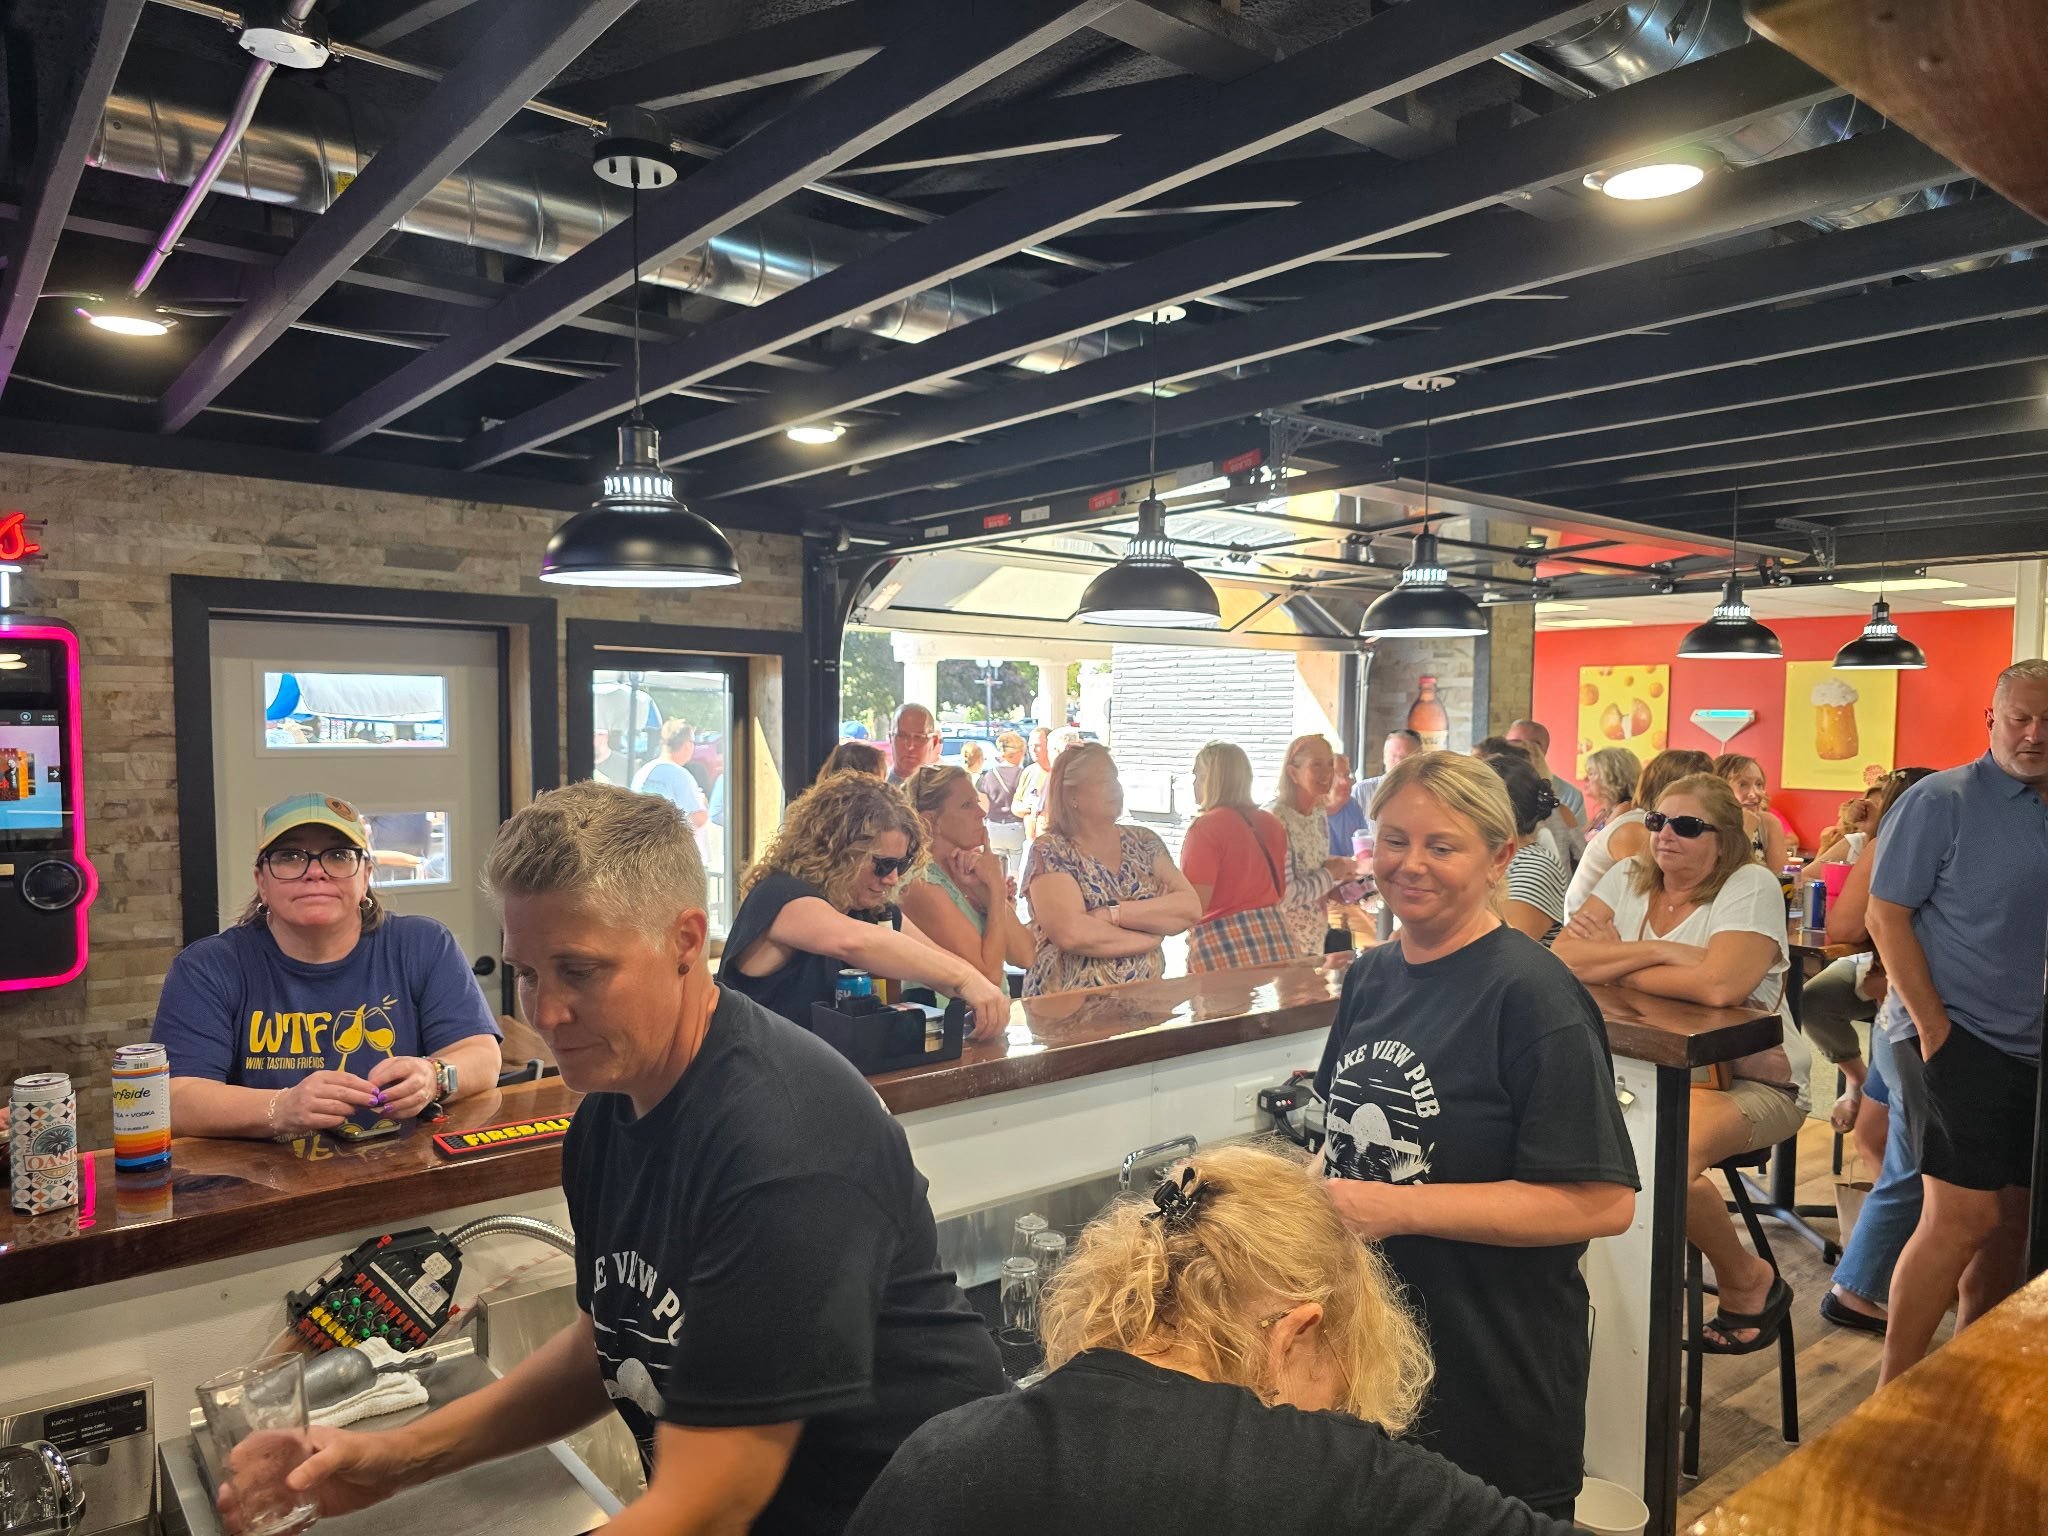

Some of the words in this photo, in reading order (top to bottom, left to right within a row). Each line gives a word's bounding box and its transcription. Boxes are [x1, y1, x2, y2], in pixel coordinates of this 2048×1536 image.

[250, 1010, 332, 1054] WTF
[246, 1057, 264, 1070] WINE
[267, 1057, 295, 1070] TASTING
[297, 1056, 325, 1070] FRIENDS
[113, 1087, 151, 1100] urfside
[1372, 1040, 1416, 1068] VIEW
[1404, 1061, 1441, 1118] PUB
[131, 1110, 155, 1119] VODKA
[652, 1288, 686, 1346] PU
